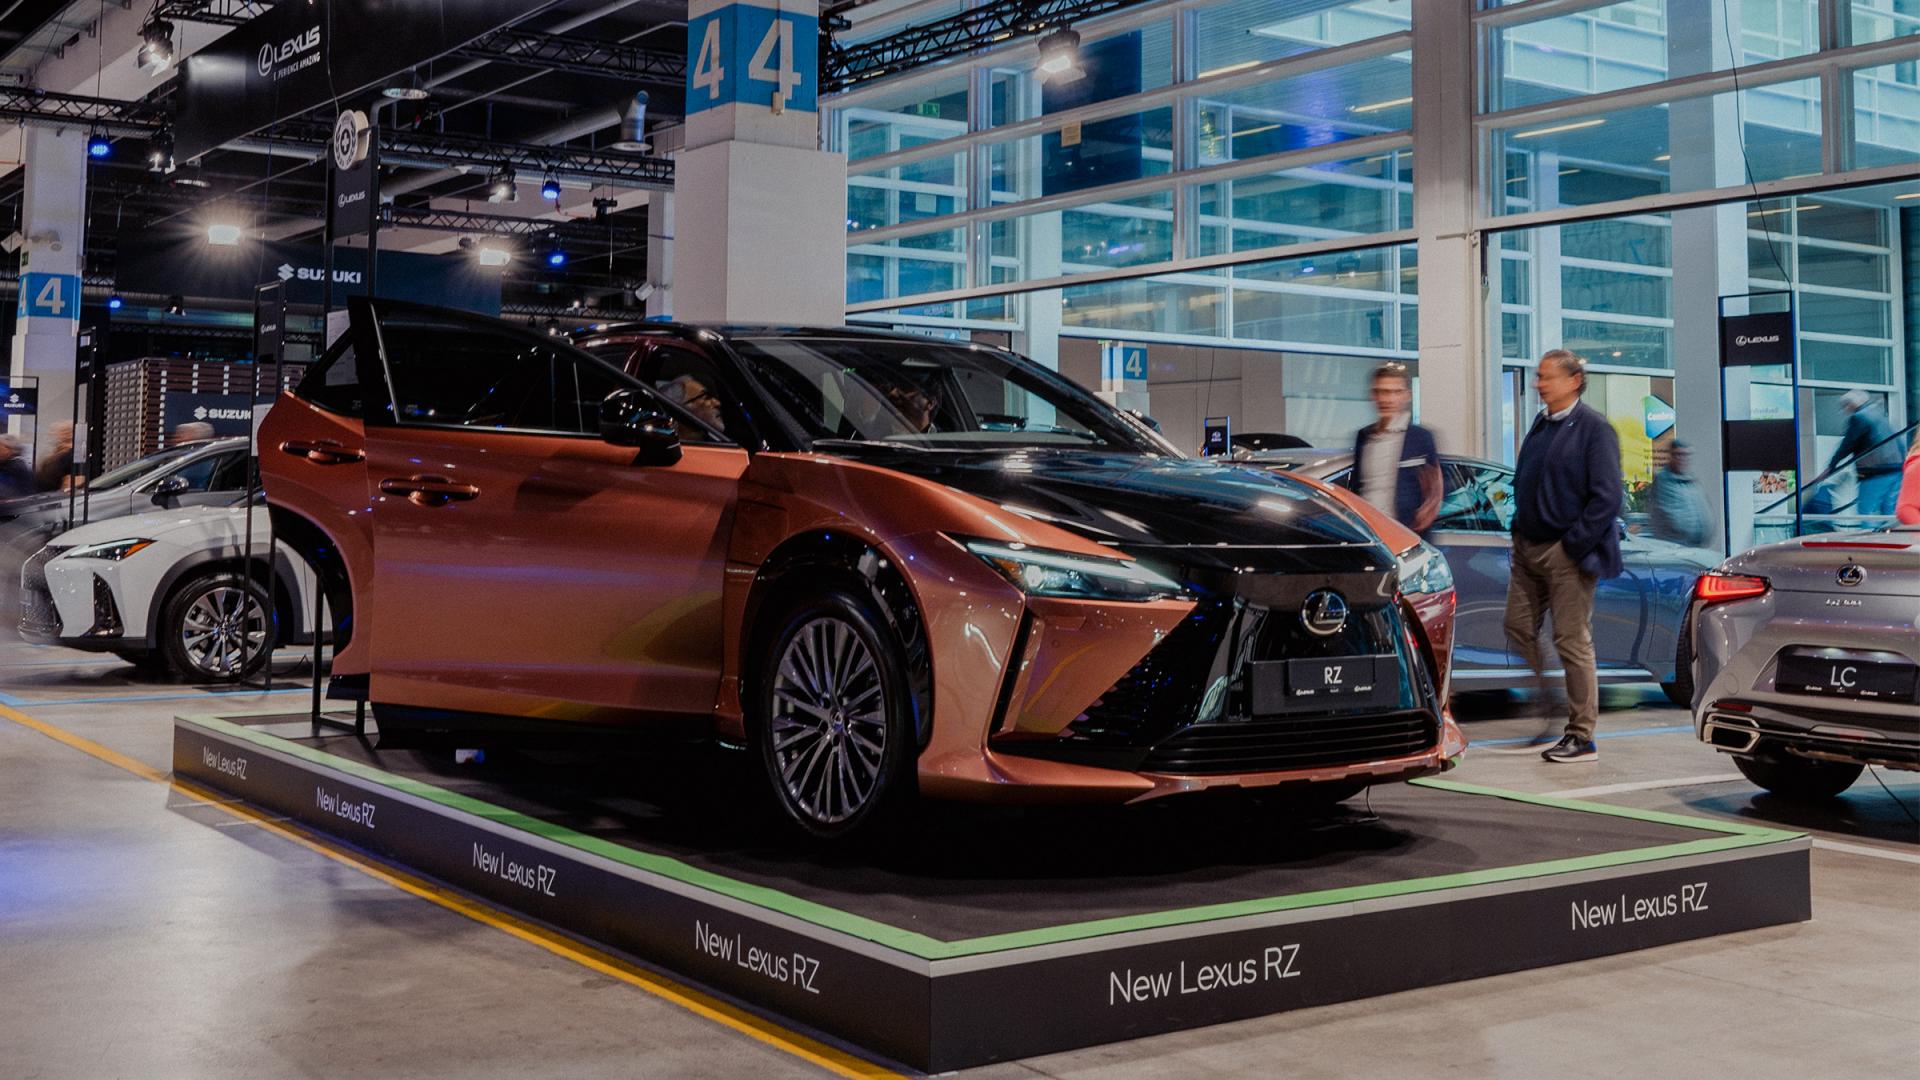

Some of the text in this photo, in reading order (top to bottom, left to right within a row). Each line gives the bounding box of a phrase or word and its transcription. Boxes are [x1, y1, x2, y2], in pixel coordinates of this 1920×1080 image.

[274, 25, 320, 63] LEXUS
[693, 17, 724, 100] 4
[748, 18, 802, 100] 4
[36, 277, 65, 315] 4
[1747, 335, 1779, 344] LEXUS
[1126, 350, 1142, 378] 4
[208, 408, 252, 419] SUZUK
[1324, 665, 1343, 685] RZ
[1830, 665, 1857, 687] LC
[203, 745, 247, 780] New Lexus RZ
[316, 786, 375, 829] New Lexus RZ
[473, 842, 556, 897] New Lexus RZ
[1571, 882, 1709, 930] New Lexus RZ
[695, 919, 820, 994] New Lexus RZ
[1110, 943, 1301, 1005] New Lexus RZ
